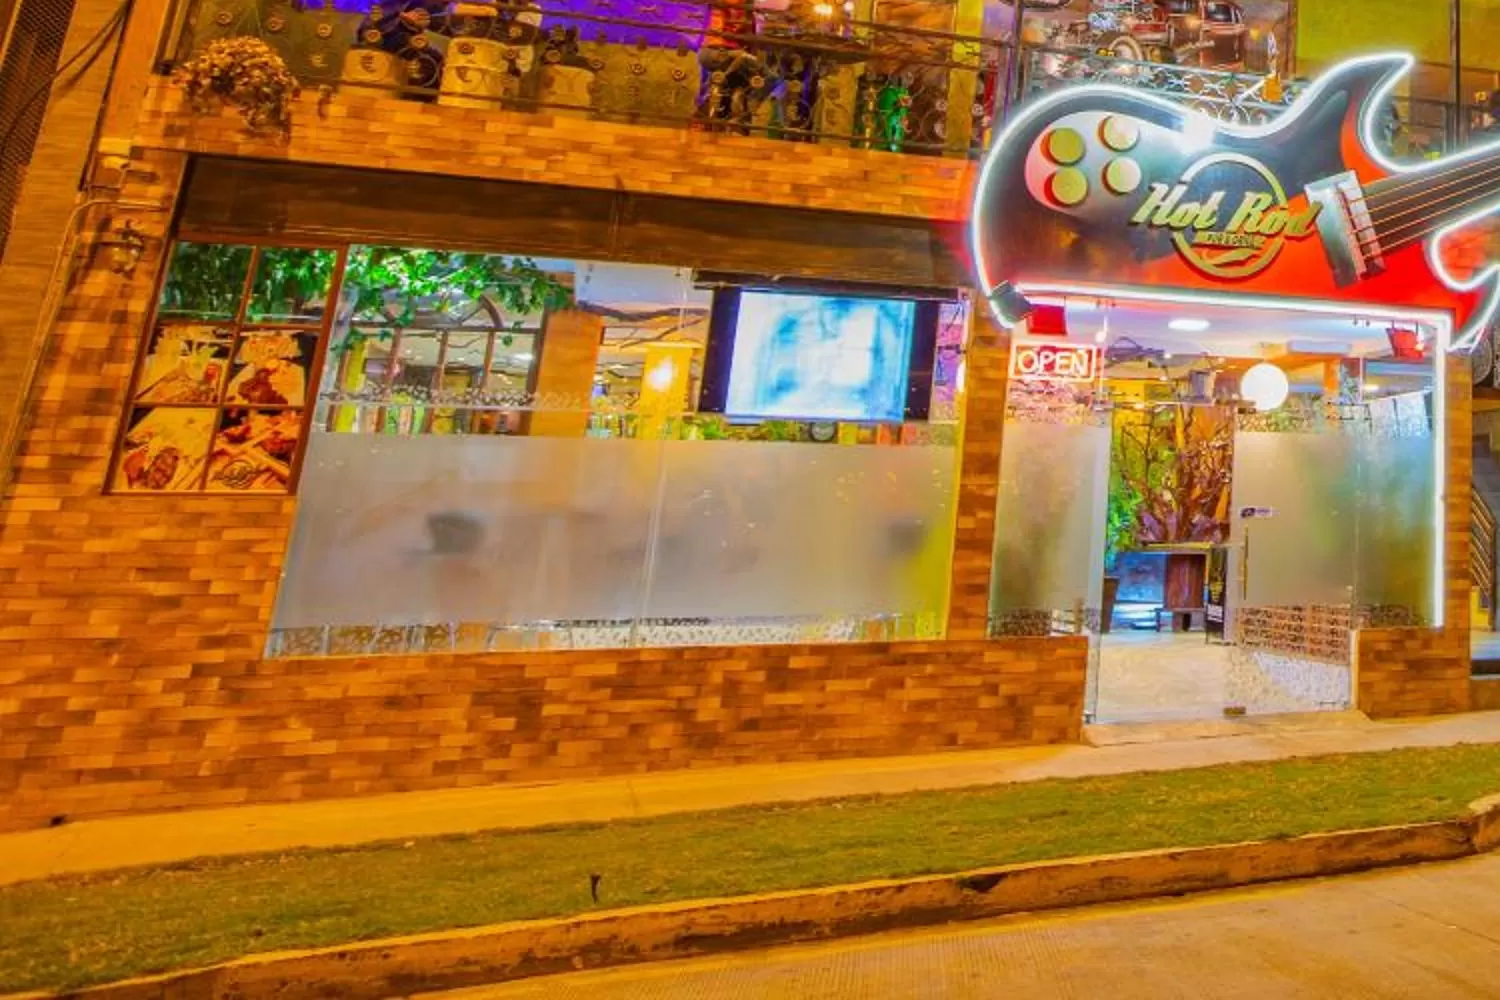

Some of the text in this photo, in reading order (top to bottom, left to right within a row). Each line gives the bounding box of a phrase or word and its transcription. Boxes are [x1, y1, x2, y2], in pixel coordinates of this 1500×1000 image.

[1130, 182, 1324, 238] Hot Rod
[1017, 350, 1089, 375] OPEN
